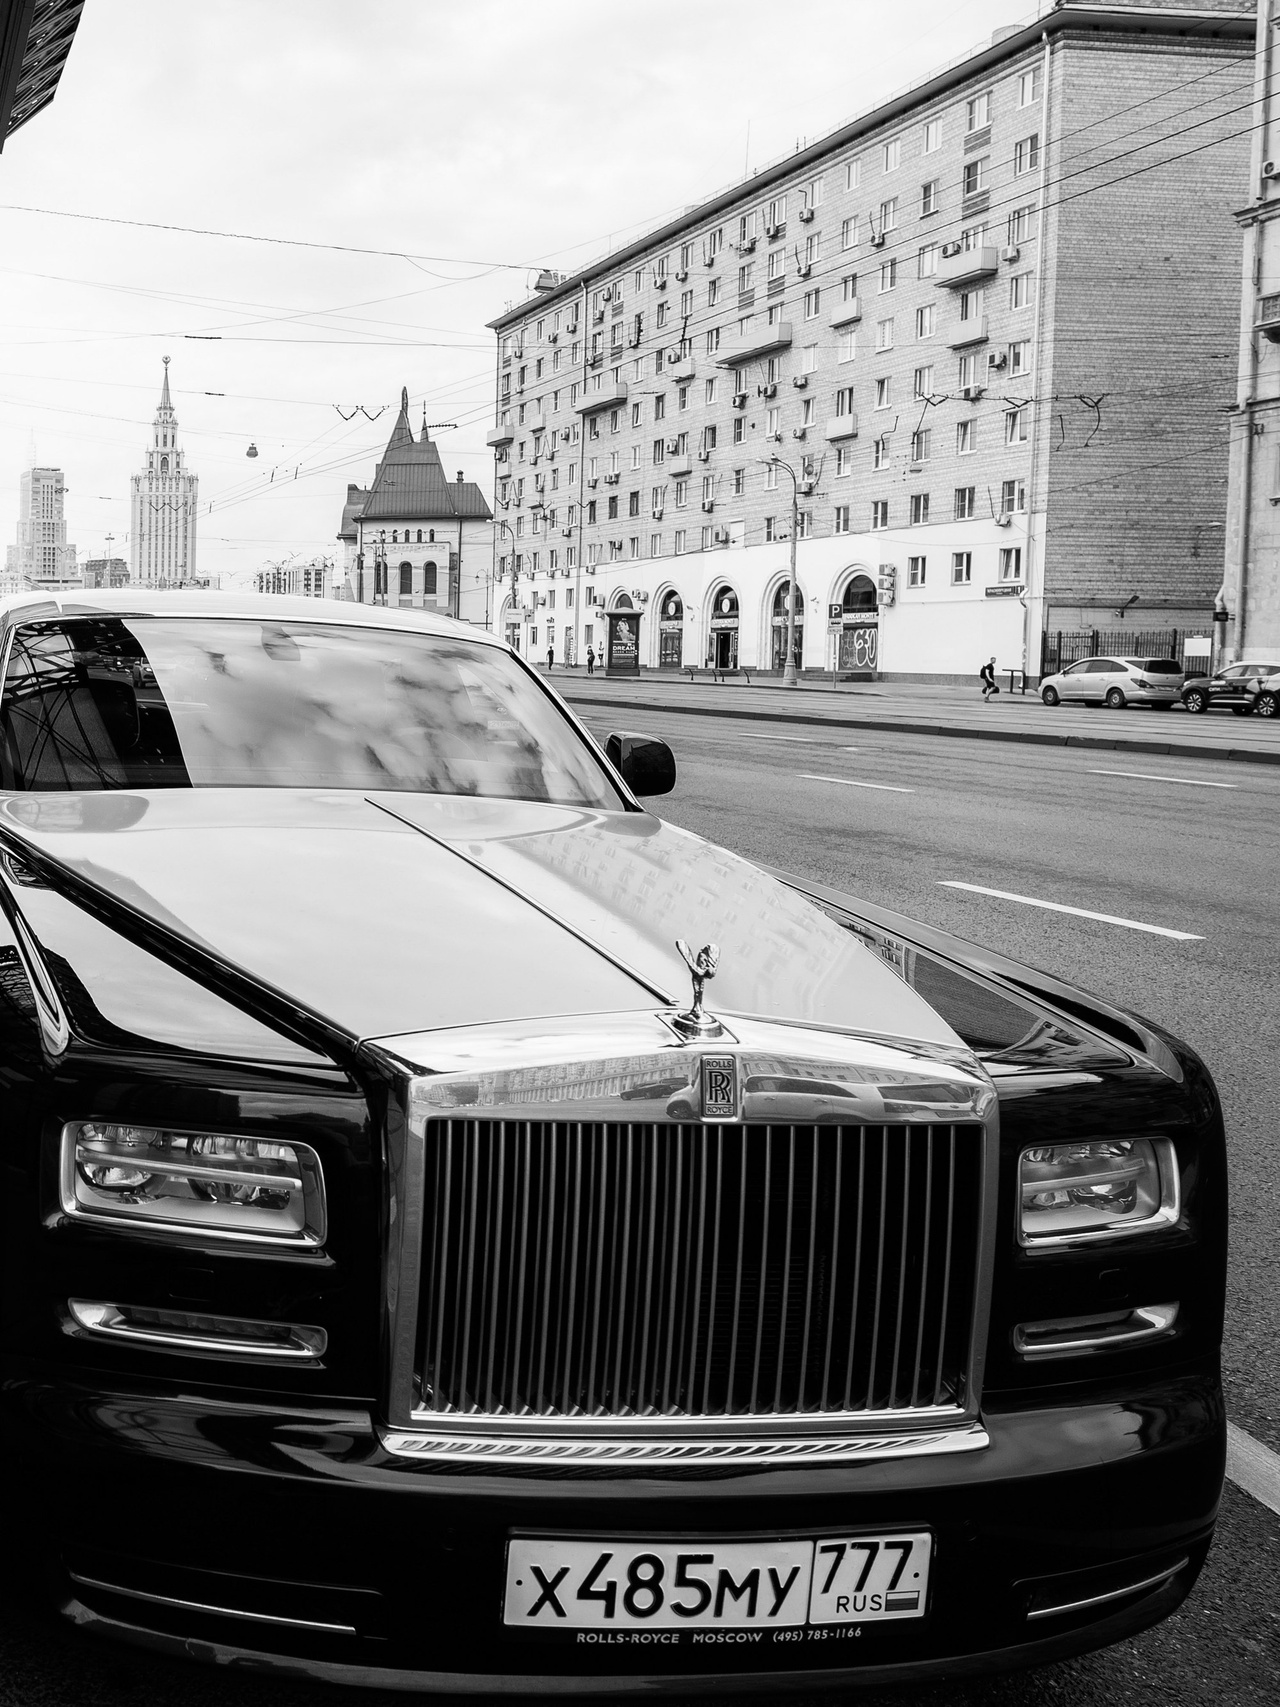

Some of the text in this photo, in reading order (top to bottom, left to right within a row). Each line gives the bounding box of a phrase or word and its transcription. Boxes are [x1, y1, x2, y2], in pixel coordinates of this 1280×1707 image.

[706, 1060, 732, 1068] ROLLS
[707, 1106, 733, 1114] ROYCE
[819, 1539, 915, 1595] 777
[836, 1594, 883, 1613] RUS
[576, 1627, 862, 1645] ROLLS-ROYCE MOSCOW (495) 785-1166
